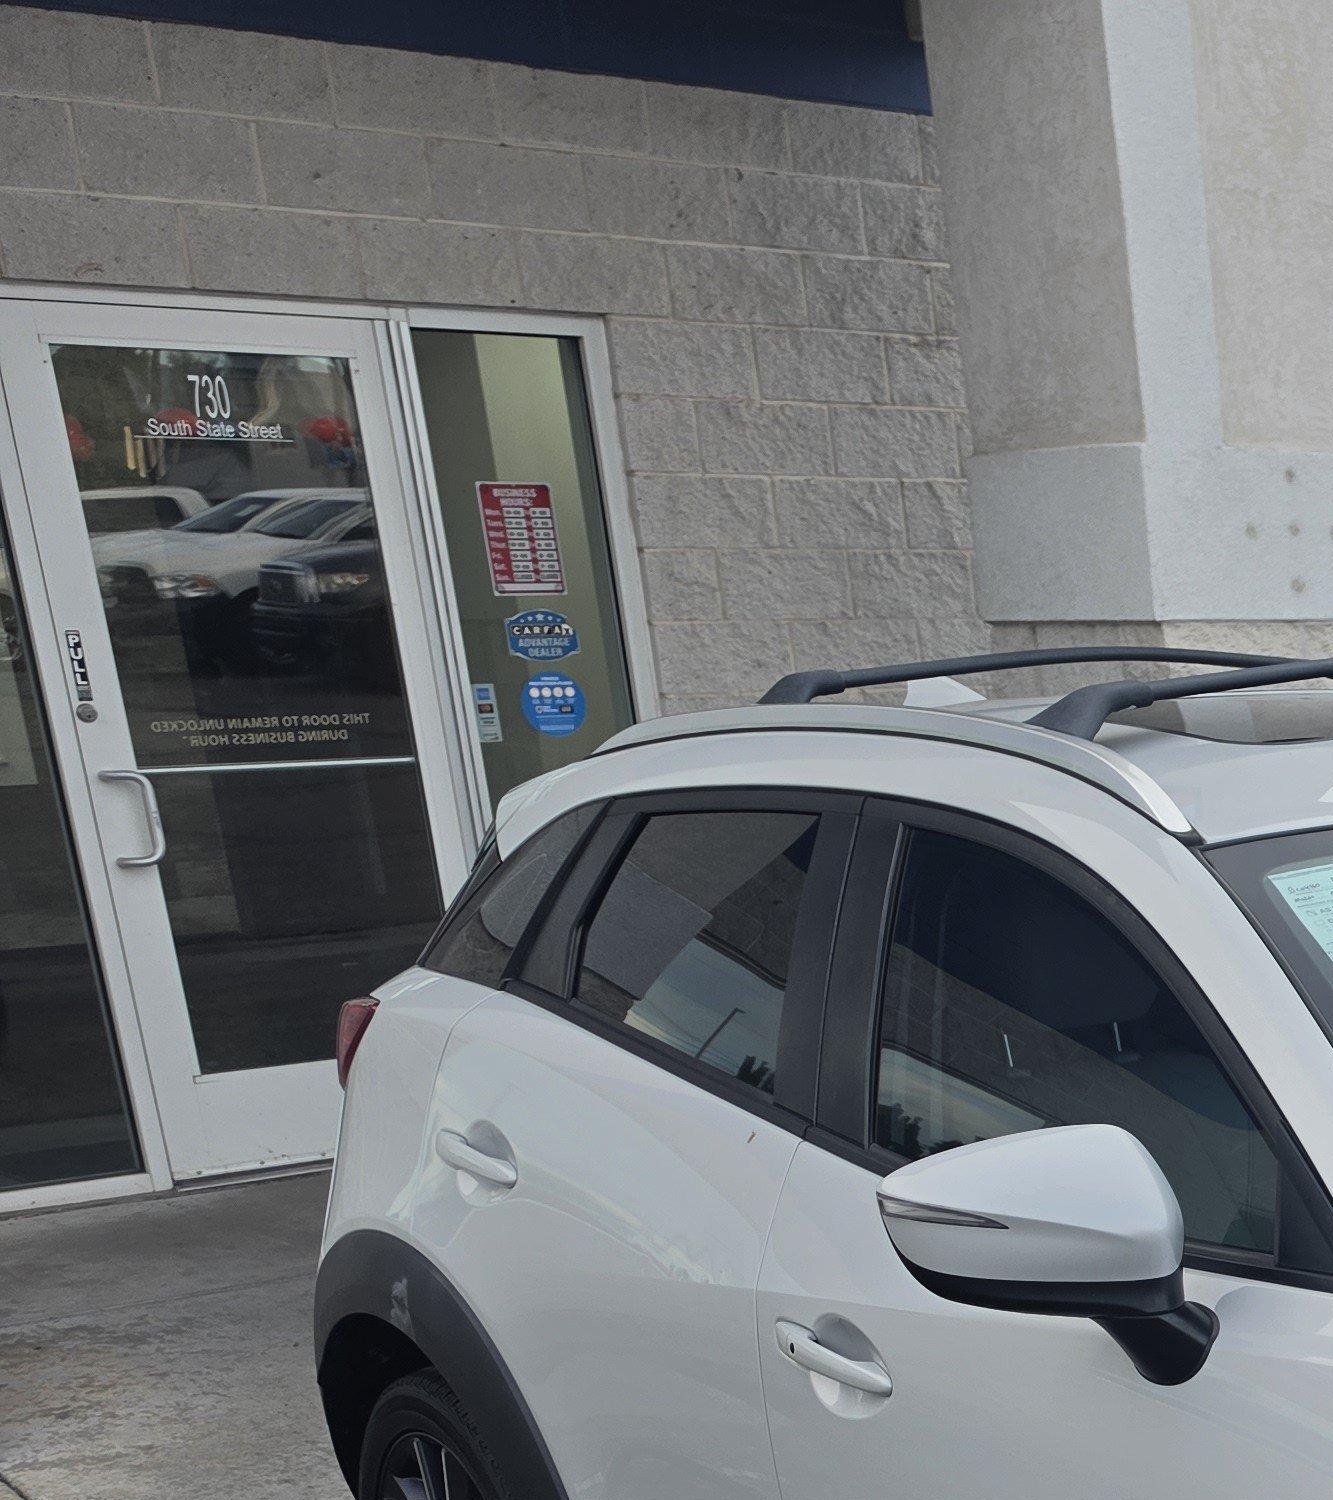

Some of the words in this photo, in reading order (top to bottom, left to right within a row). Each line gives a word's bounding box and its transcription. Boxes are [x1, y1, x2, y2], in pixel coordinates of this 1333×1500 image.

[187, 374, 231, 419] 730
[147, 418, 193, 436] South
[195, 420, 236, 438] State
[238, 421, 283, 439] Street
[518, 637, 571, 647] ADVANTAGE
[528, 647, 563, 657] DEALER
[67, 634, 88, 685] PULL
